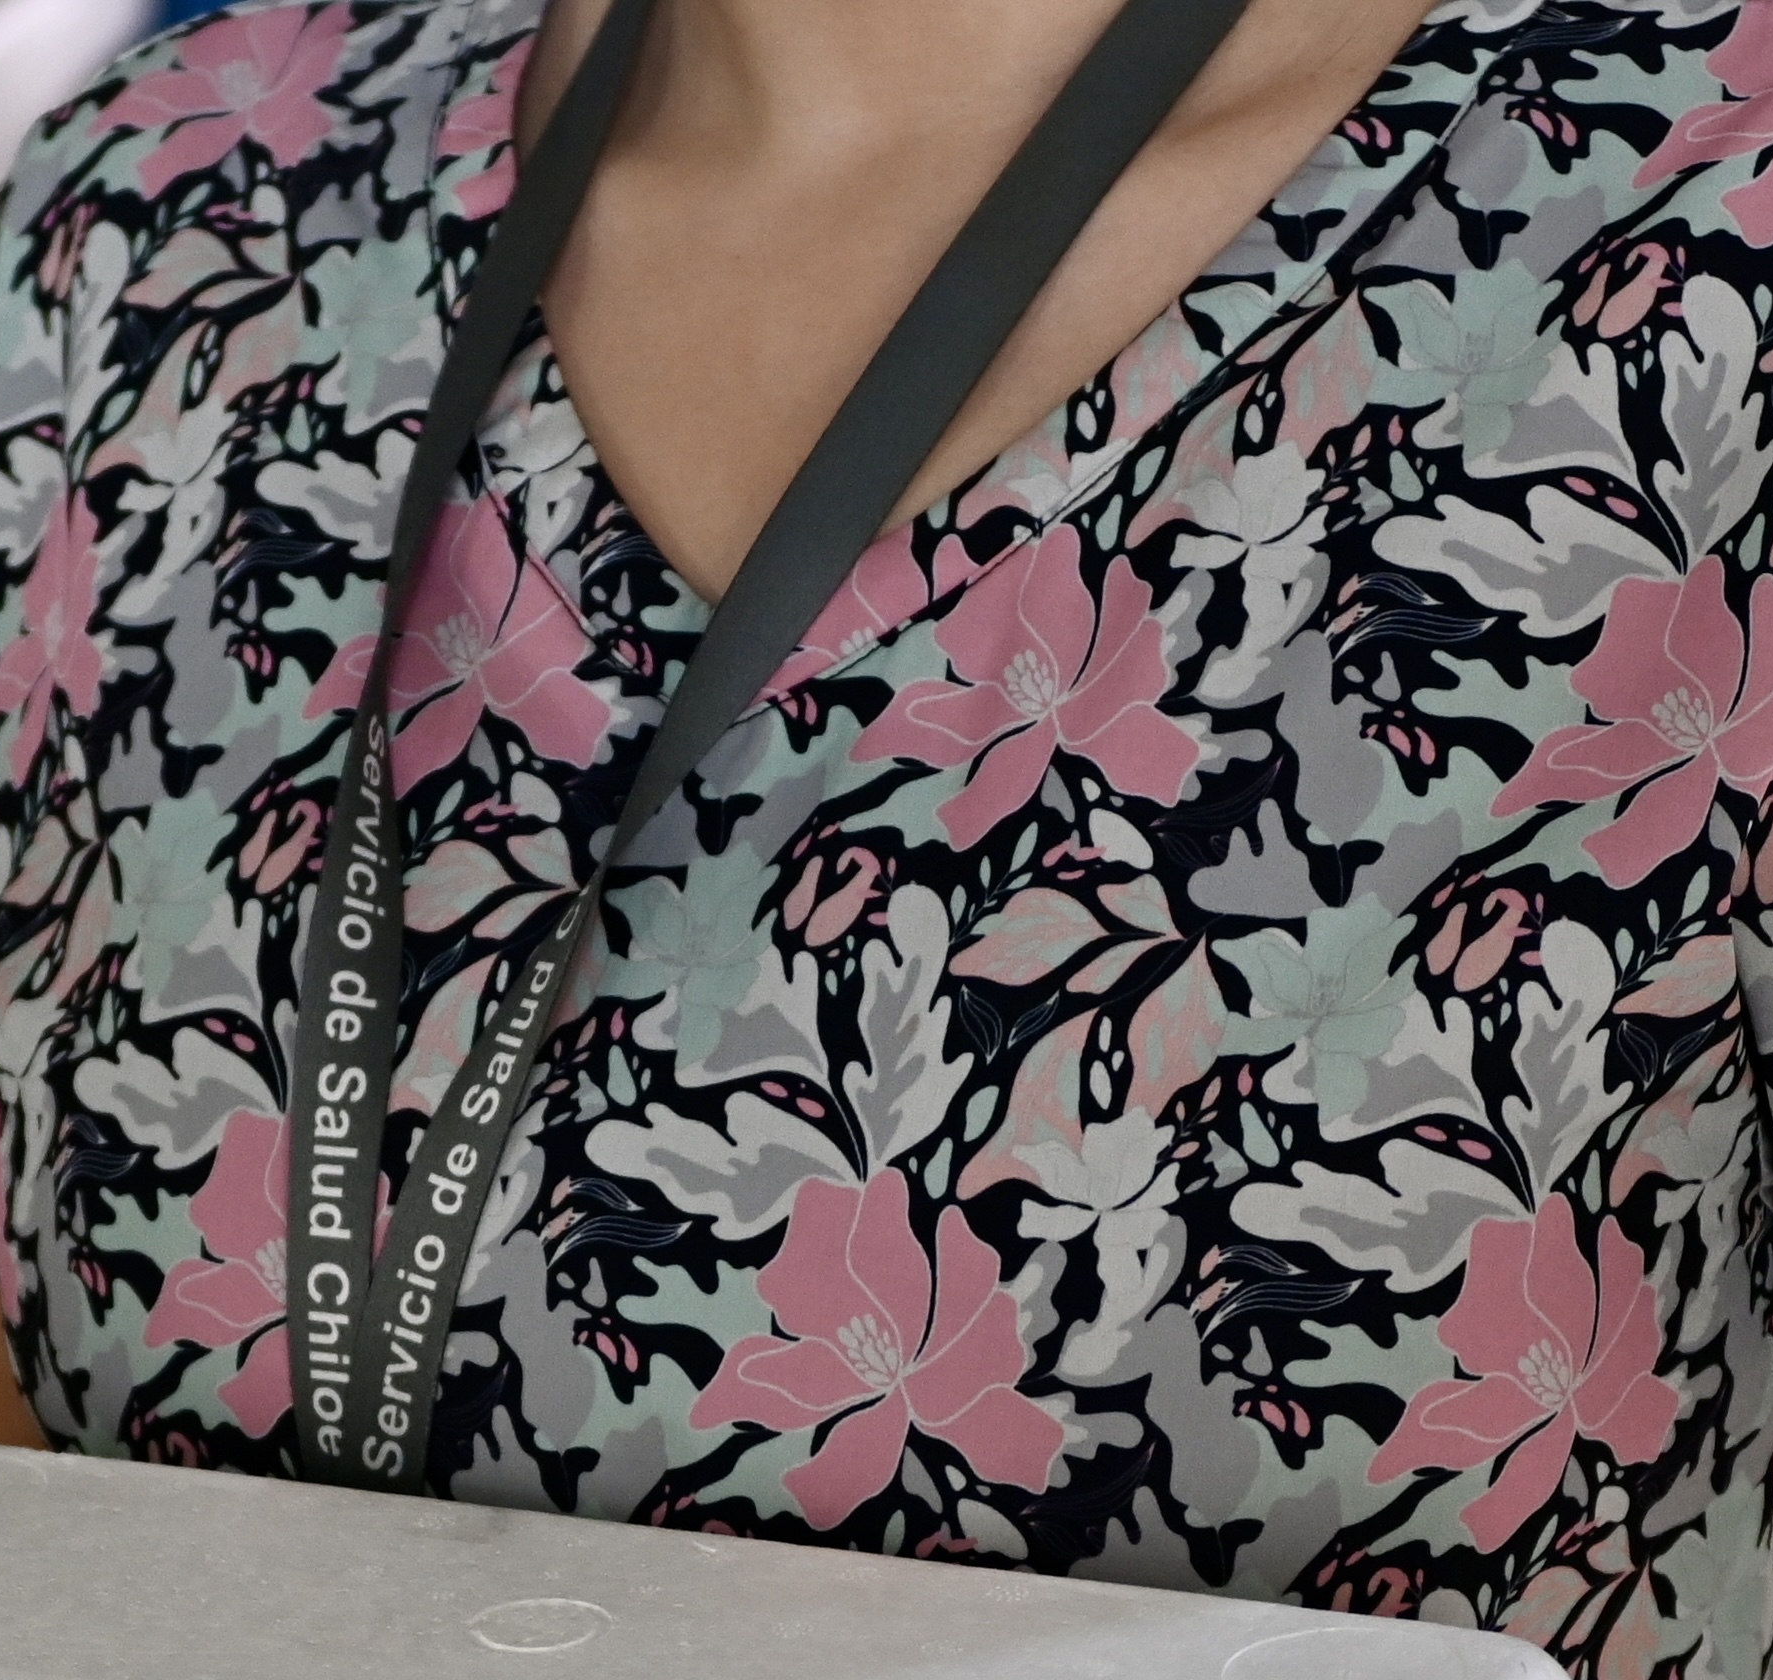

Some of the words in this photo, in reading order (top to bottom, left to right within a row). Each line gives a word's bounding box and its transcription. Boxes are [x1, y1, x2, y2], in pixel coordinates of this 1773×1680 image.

[336, 713, 388, 952] Servicio
[324, 970, 378, 1043] de
[309, 1062, 368, 1241] Salud
[362, 1234, 447, 1478] Servicio
[427, 1142, 479, 1217] de
[460, 961, 556, 1125] Salud
